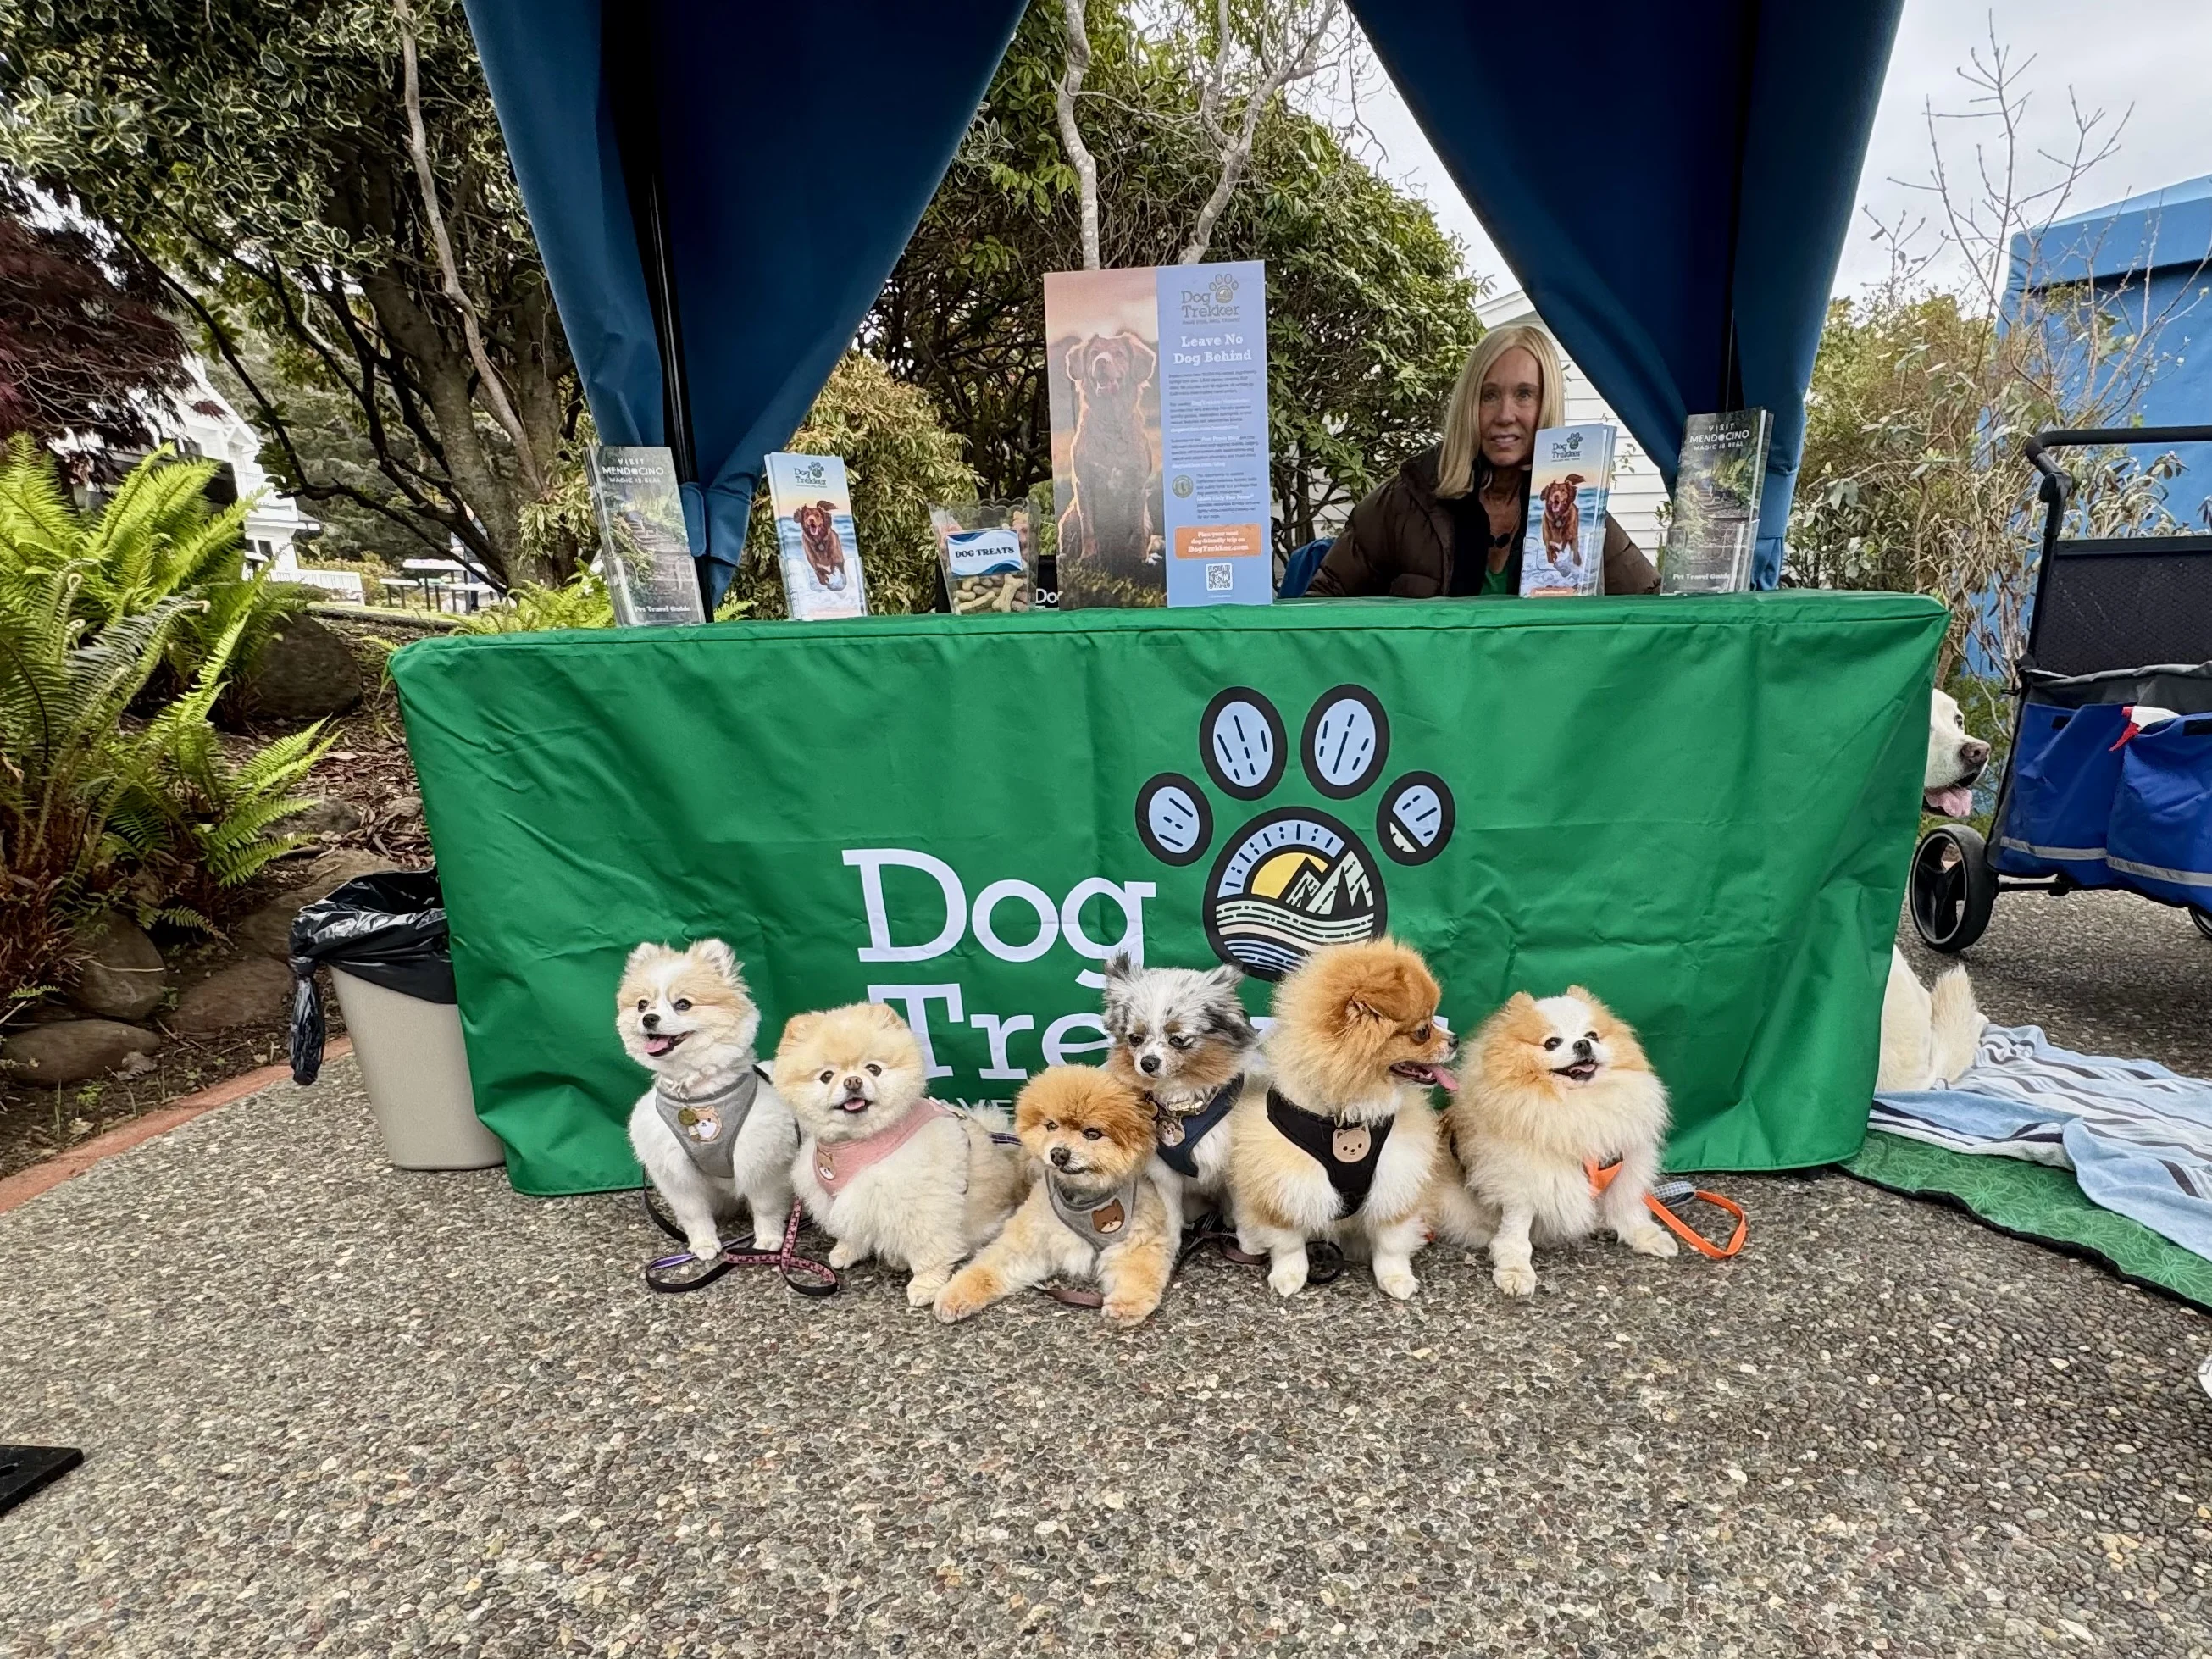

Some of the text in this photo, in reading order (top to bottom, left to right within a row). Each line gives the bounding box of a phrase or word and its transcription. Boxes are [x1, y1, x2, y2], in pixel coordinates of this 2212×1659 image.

[1181, 291, 1211, 306] Dog
[1181, 305, 1240, 319] Trekker
[1180, 333, 1244, 347] Leave No
[1173, 349, 1252, 366] Dog Behind
[1708, 423, 1735, 433] VISIT
[1689, 430, 1750, 443] MENDOCINO
[602, 466, 664, 475] MENDOCINO
[955, 547, 1015, 558] DOG TREATS
[1034, 588, 1060, 604] Do
[841, 848, 1156, 990] Dog
